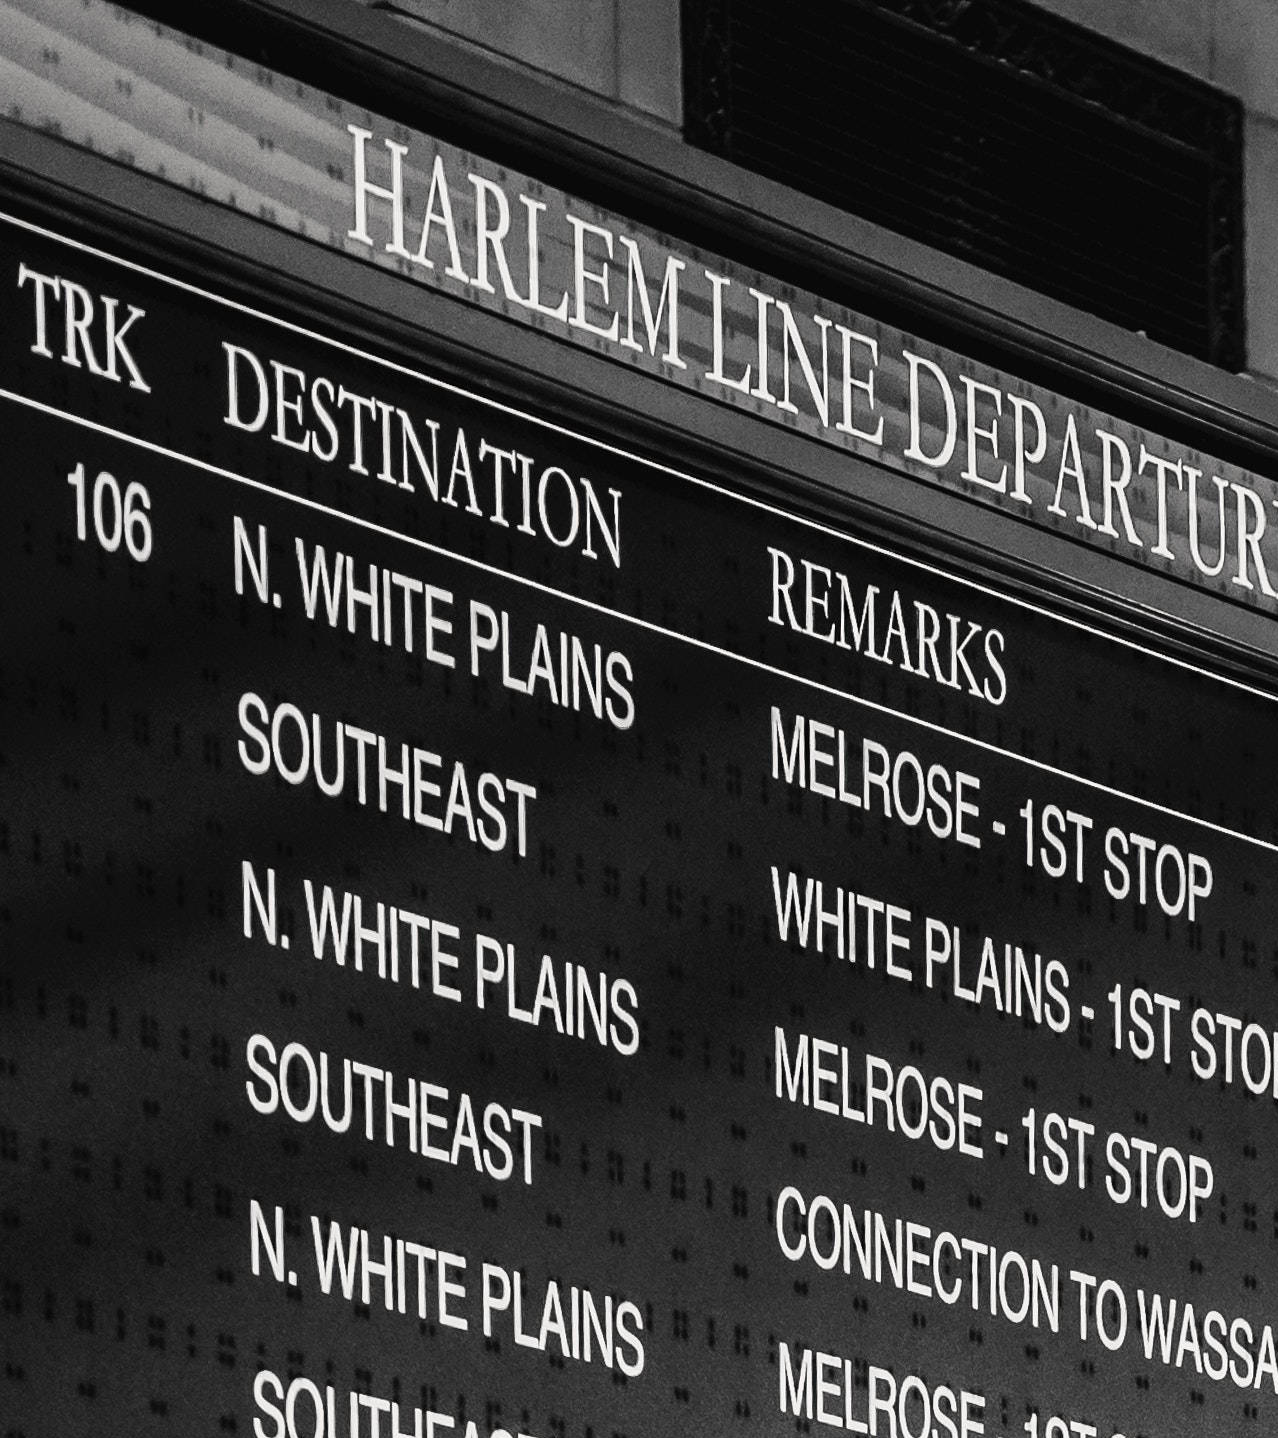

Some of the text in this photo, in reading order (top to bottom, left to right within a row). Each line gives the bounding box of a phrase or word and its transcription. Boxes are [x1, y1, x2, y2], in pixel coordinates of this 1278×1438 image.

[19, 263, 150, 393] TRK
[349, 126, 686, 368] HARLEM
[706, 271, 883, 444] LINE
[68, 464, 151, 561] 106
[222, 342, 621, 568] DESTINATION
[234, 516, 634, 728] N. WHITE PLAINS
[768, 547, 1006, 705] REMARKS
[239, 693, 536, 856] SOUTHEAST
[772, 707, 1212, 921] MELROSE - 1ST STOP
[243, 861, 639, 1055] N. WHITE PLAINS
[771, 867, 912, 981] WHITE
[926, 918, 1070, 1032] PLAINS
[1082, 1006, 1094, 1019] -
[1108, 984, 1180, 1063] 1ST
[246, 1034, 542, 1184] SOUTHEAST
[775, 1026, 1213, 1222] MELROSE - 1ST STOP
[251, 1200, 644, 1376] N. WHITE PLAINS
[777, 1187, 1058, 1332] CONNECTION
[1070, 1271, 1127, 1350] TO
